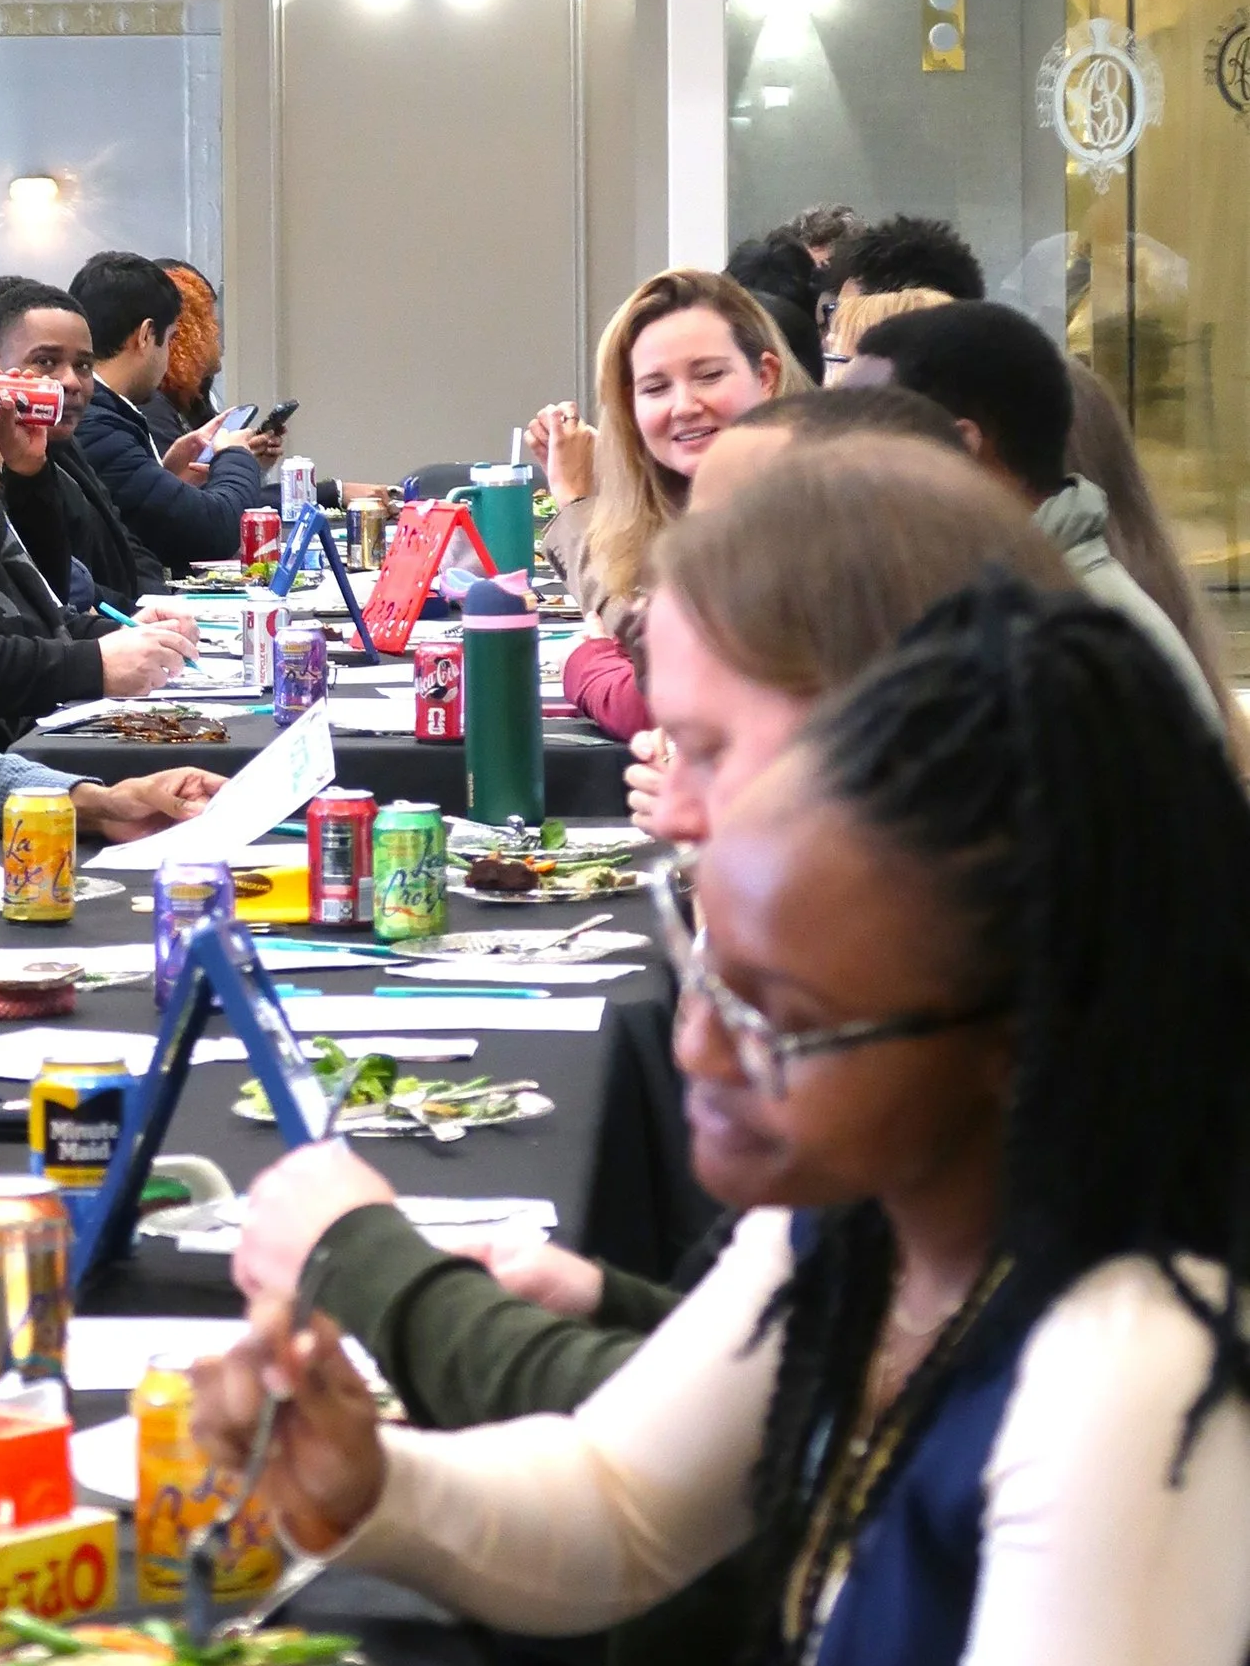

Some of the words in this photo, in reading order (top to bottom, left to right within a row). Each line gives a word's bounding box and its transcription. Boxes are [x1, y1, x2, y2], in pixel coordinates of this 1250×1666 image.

[5, 818, 31, 863] La
[410, 828, 444, 880] La
[50, 1120, 119, 1140] Minute
[57, 1140, 112, 1162] Maid
